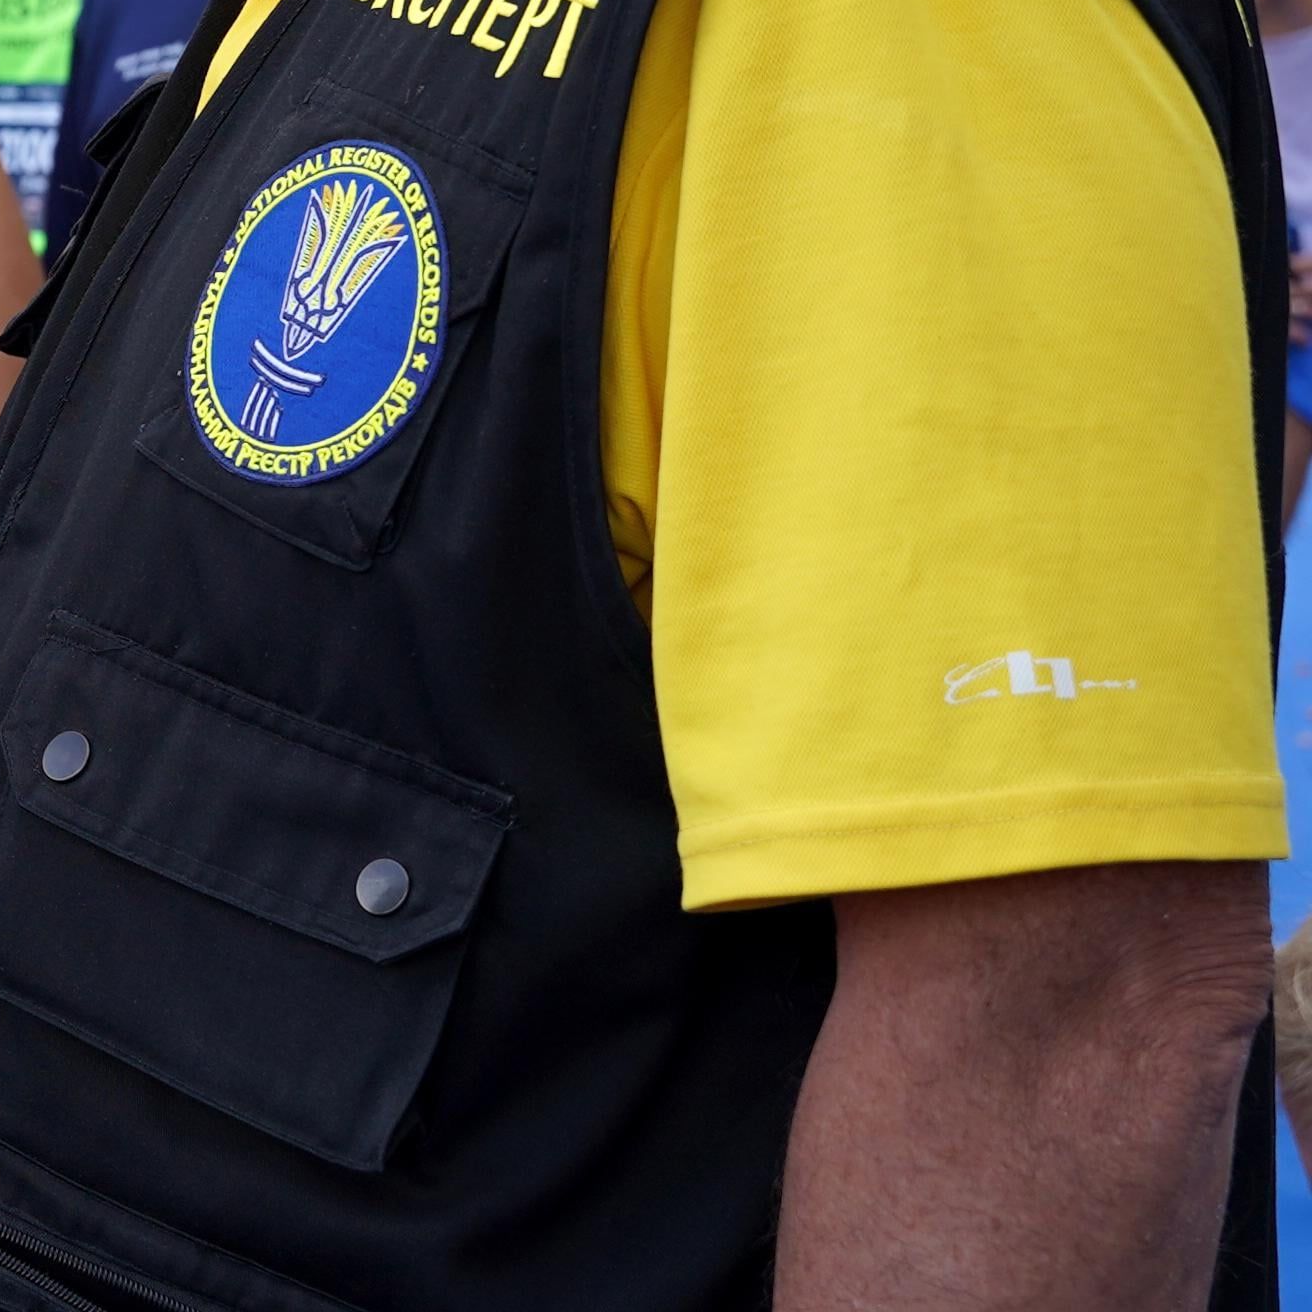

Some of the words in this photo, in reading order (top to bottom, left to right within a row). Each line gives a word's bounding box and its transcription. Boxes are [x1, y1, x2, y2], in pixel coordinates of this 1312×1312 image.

[236, 154, 325, 243] NATIONAL
[329, 147, 411, 192] REGISTER
[405, 181, 429, 212] OF
[415, 211, 441, 345] RECORDS
[187, 271, 240, 459] НАЦІОНАЛЬНИЙ
[234, 443, 314, 478] РЕЄСТР
[316, 377, 418, 474] РЕКОРДІВ
